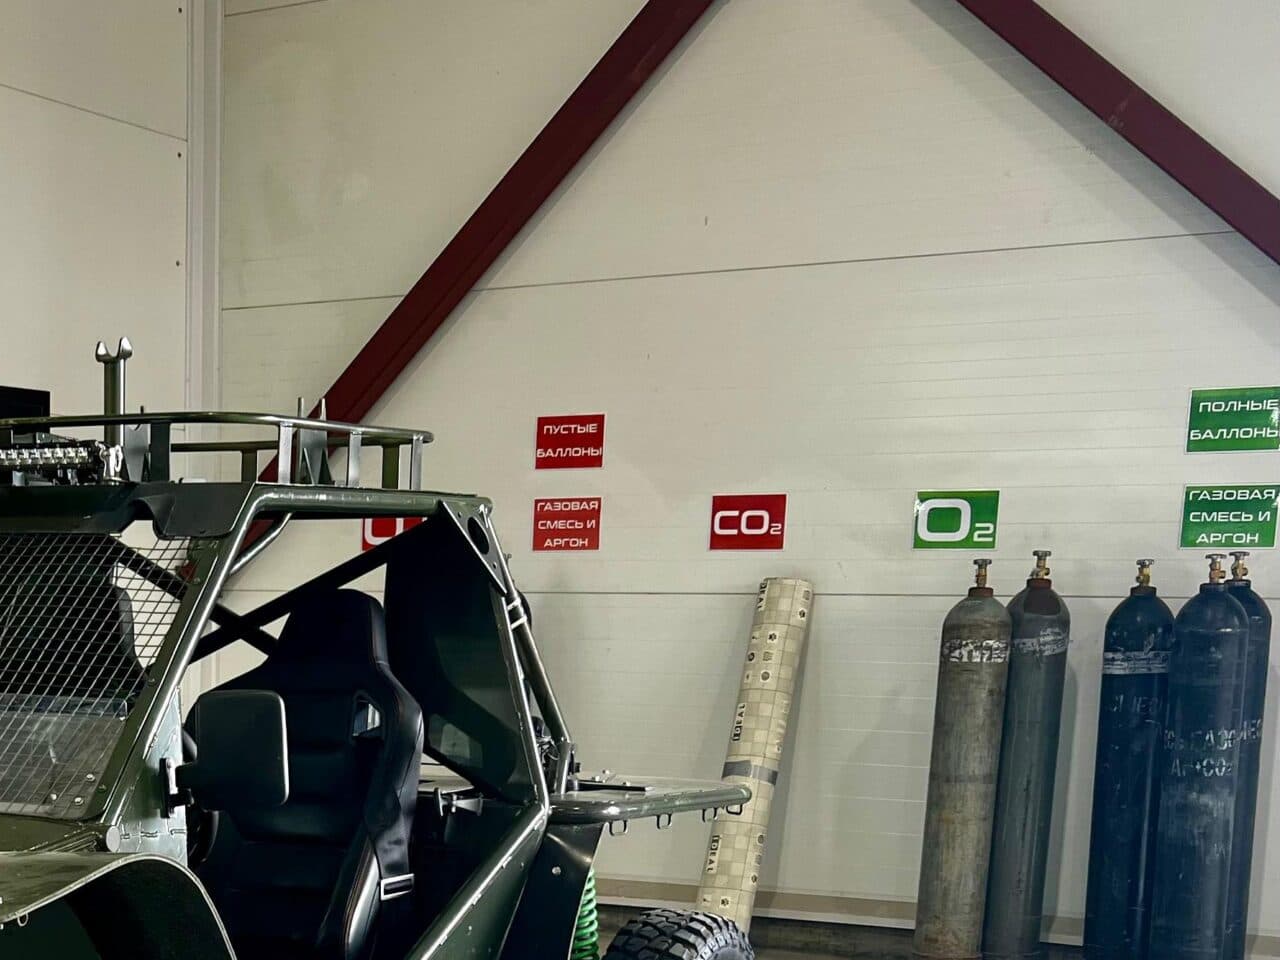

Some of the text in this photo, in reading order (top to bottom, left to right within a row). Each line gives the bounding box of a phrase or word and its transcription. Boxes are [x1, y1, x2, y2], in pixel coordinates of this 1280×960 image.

[1199, 399, 1279, 412] ПОЛНЫЕ
[543, 423, 598, 435] ПУСТЫЕ
[536, 446, 603, 458] БАЛЛОНЫ
[1189, 488, 1276, 501] ГАЗОВАЯ
[537, 500, 599, 511] ГАЗОВАЯ
[1189, 511, 1271, 522] СМЕСЬ И
[538, 519, 596, 530] СМЕСЬ И
[543, 537, 589, 548] АРГОН
[1195, 533, 1259, 544] АРГОН
[706, 834, 721, 873] IDEAL
